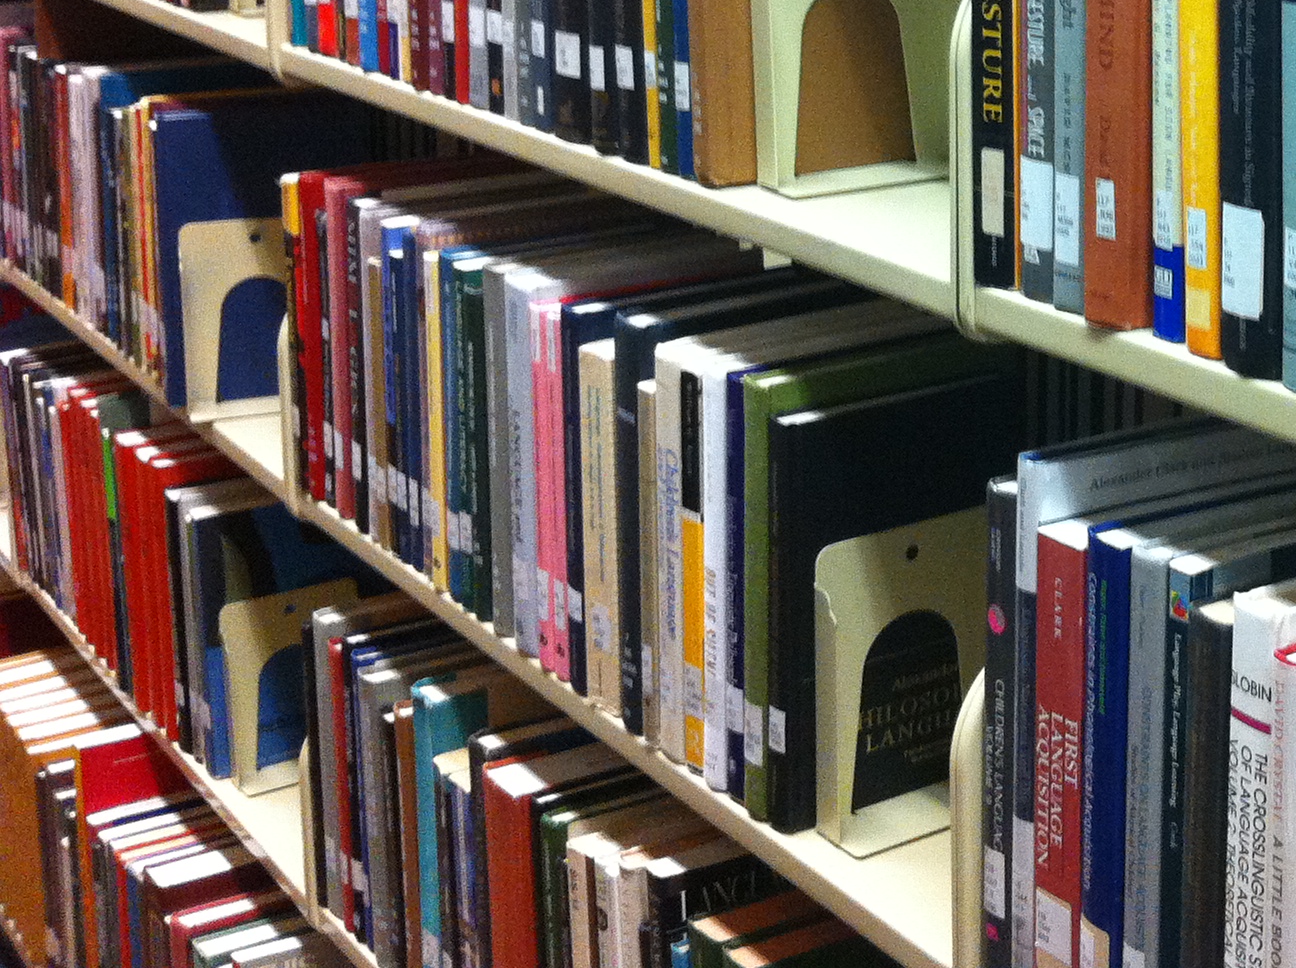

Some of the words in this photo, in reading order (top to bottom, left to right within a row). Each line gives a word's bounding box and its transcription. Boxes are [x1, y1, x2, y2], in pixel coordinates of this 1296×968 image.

[1054, 576, 1063, 640] CLARK
[1036, 704, 1049, 870] ACQUISITION
[1049, 710, 1063, 850] LANGUAGE
[1064, 718, 1078, 789] FIRST
[1240, 745, 1253, 775] OF
[1254, 752, 1268, 794] THE
[1237, 781, 1252, 883] LANGUAGE
[1249, 788, 1266, 951] CROSSLINGUISTIC
[1271, 853, 1282, 919] LITTLE
